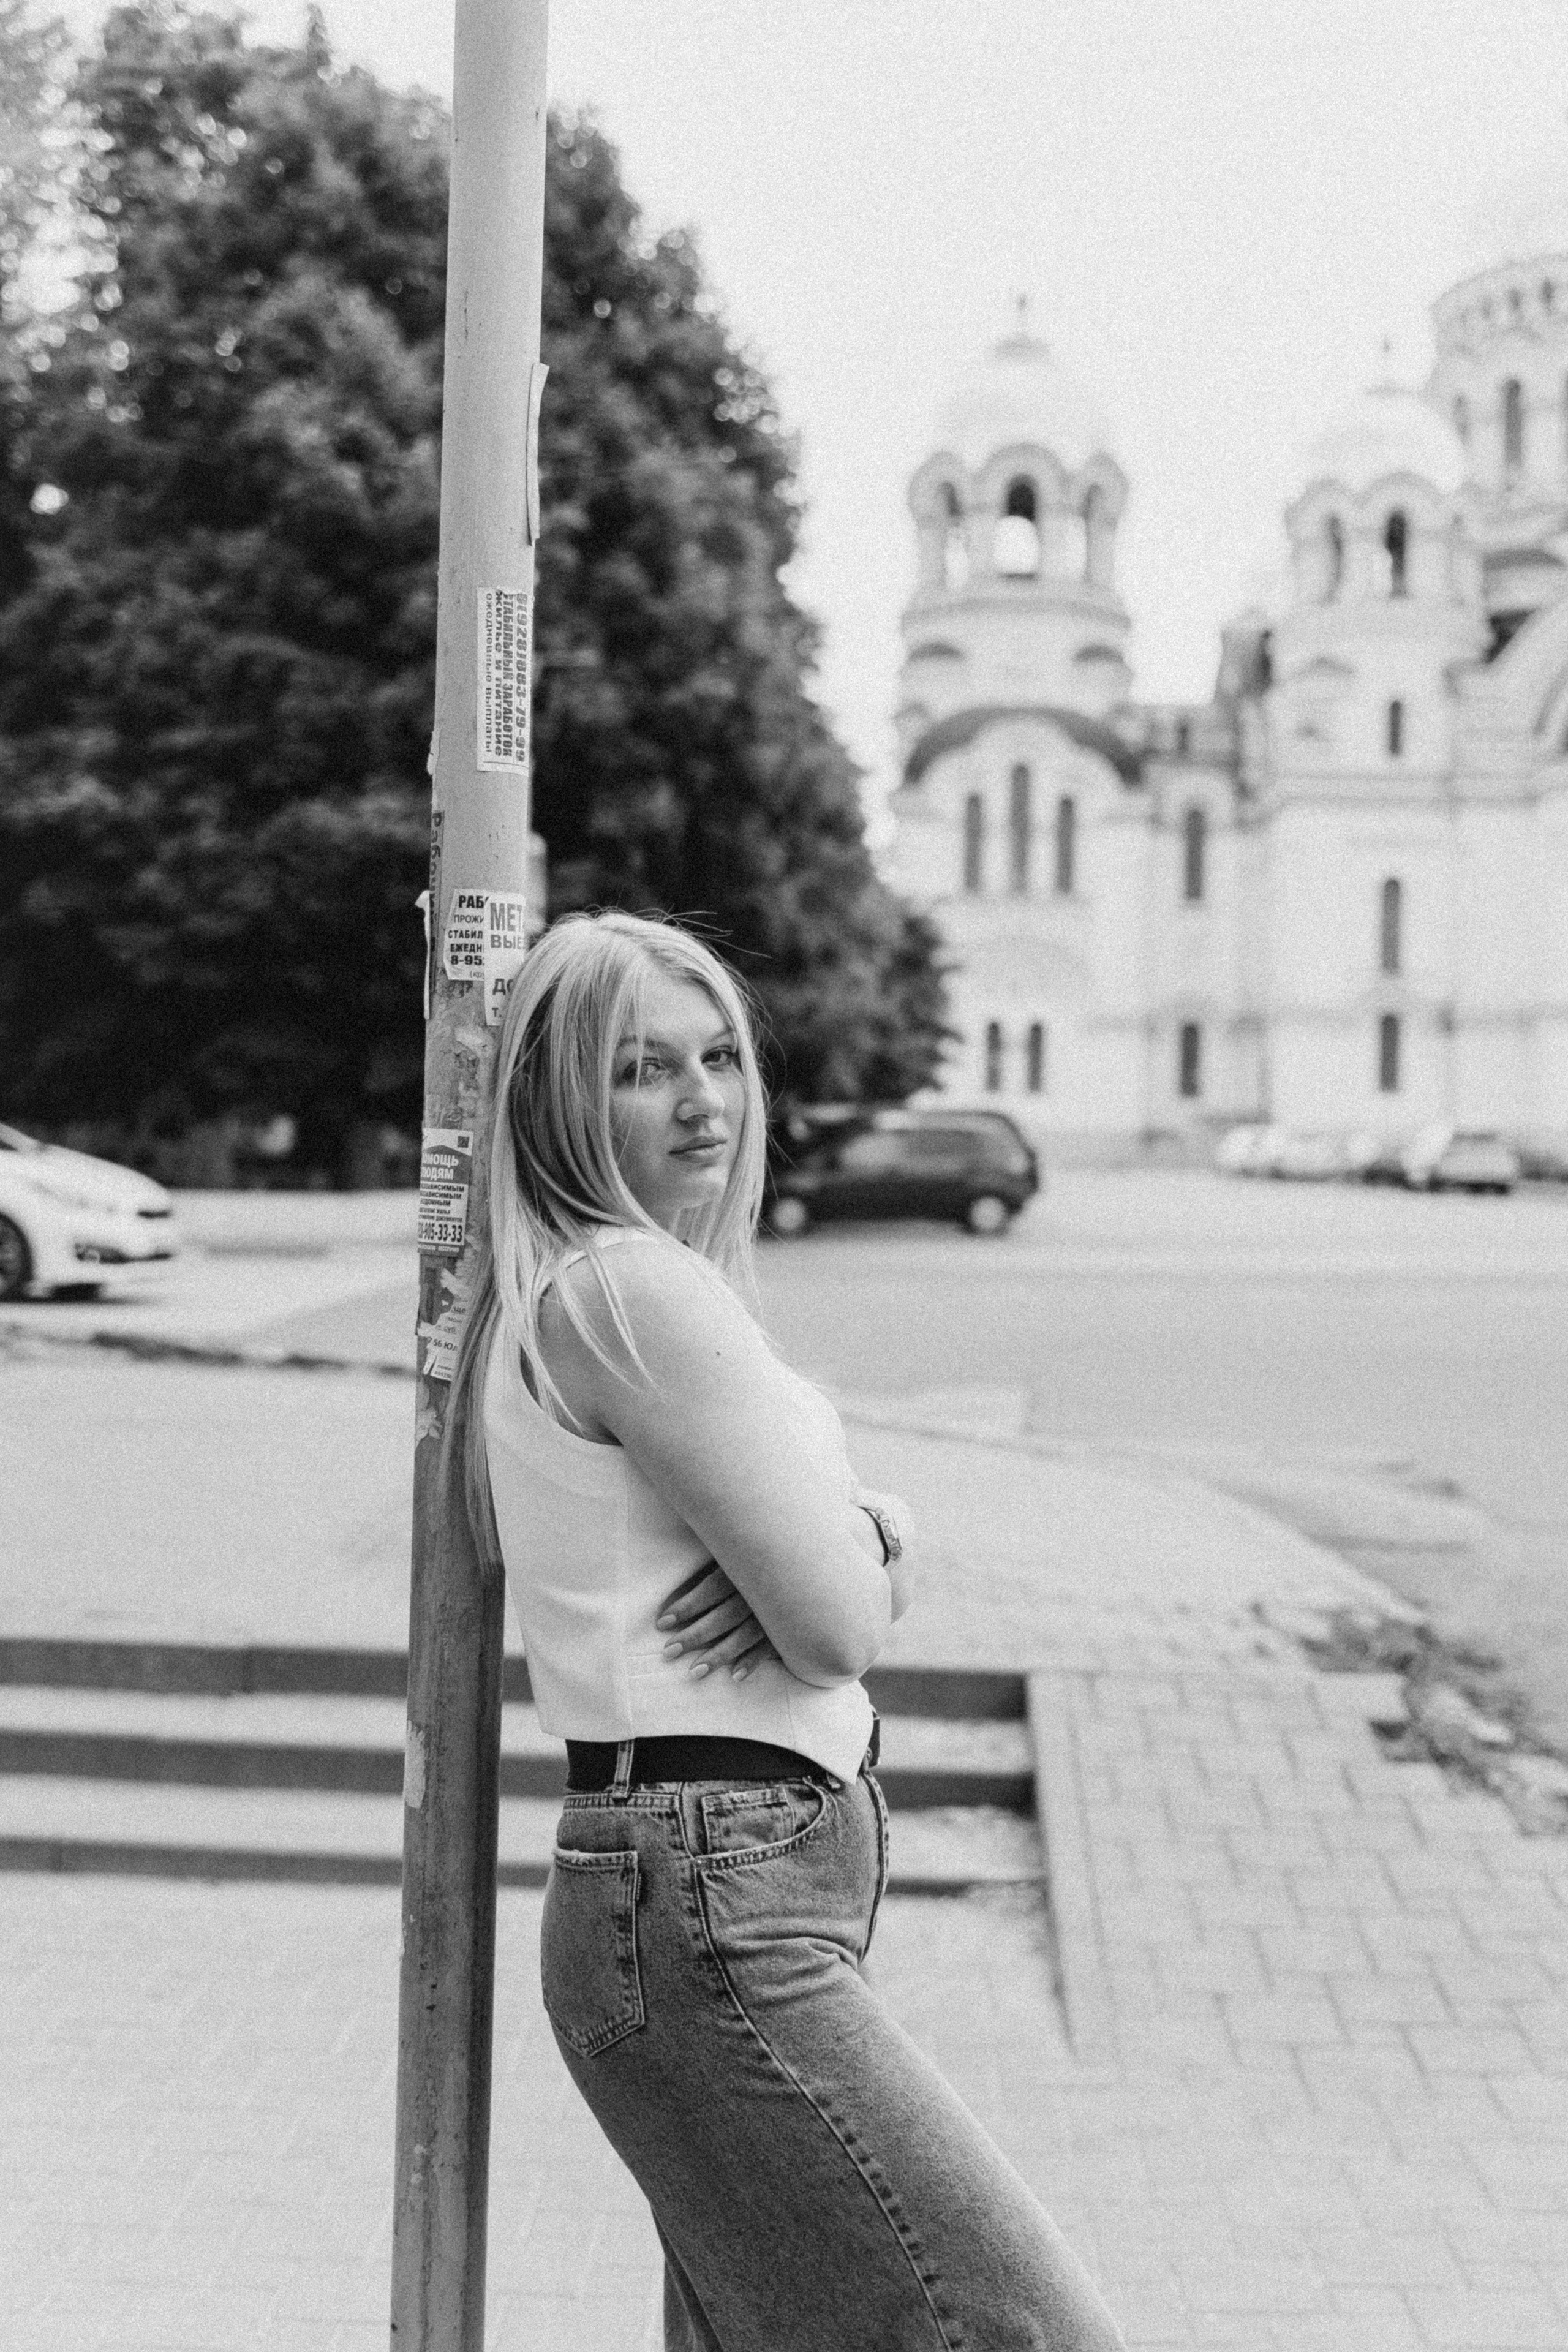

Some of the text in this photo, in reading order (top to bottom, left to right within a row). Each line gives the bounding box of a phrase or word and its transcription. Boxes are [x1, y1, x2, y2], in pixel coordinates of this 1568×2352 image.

[495, 660, 502, 671] и
[502, 683, 513, 757] ЗАРАБОТОК
[458, 894, 489, 909] РАБ
[448, 929, 483, 940] СТАБИЛ
[450, 943, 484, 954] ЕЖЕДН
[450, 954, 485, 967] 8-95
